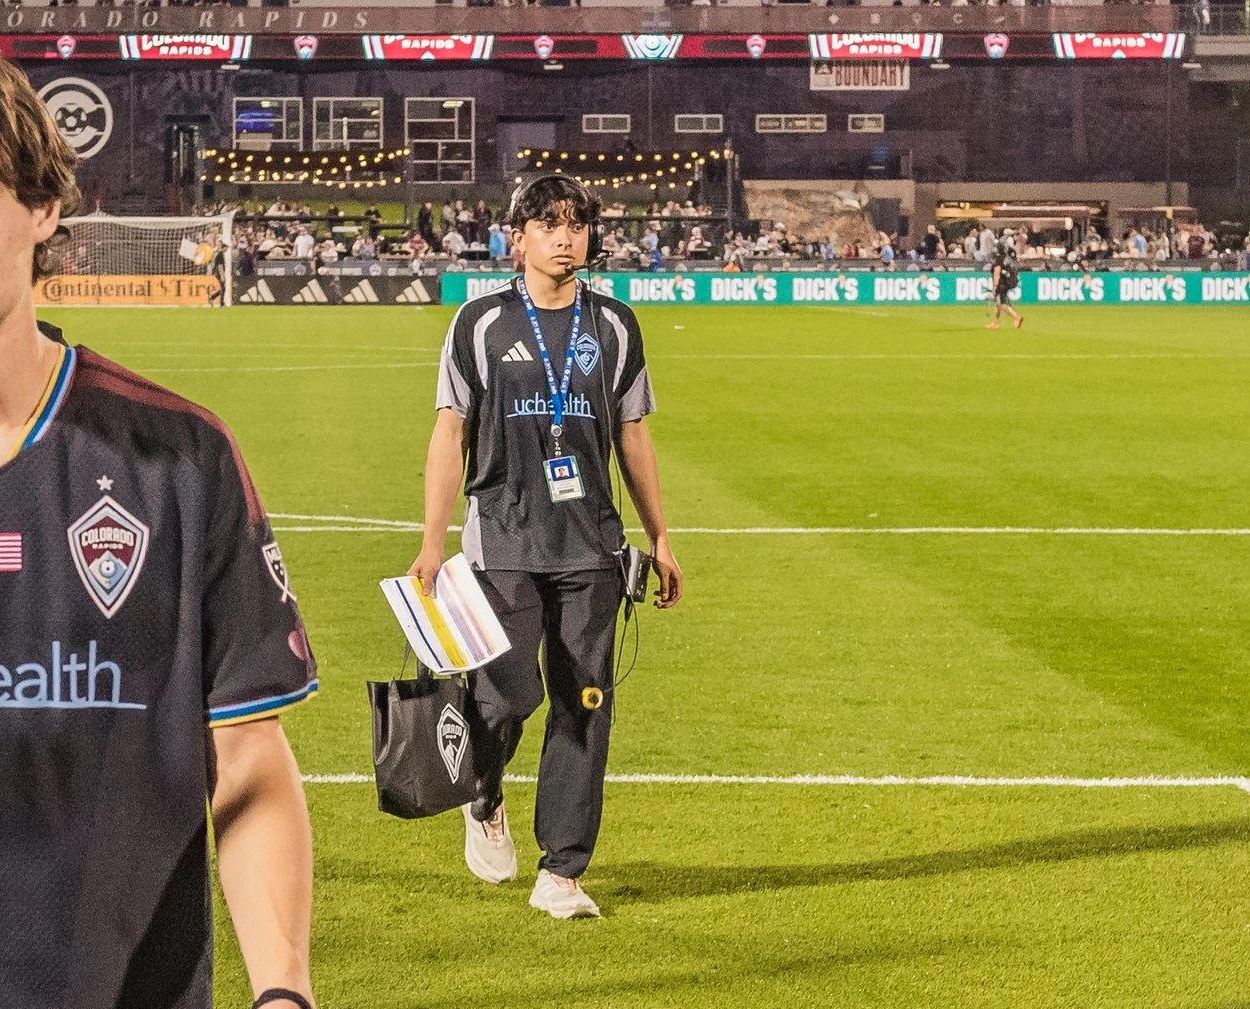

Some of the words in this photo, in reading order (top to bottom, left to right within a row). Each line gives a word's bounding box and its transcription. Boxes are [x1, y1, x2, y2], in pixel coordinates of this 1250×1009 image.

[199, 11, 369, 28] RAPIDS
[158, 45, 213, 55] RAPIDS
[401, 39, 455, 49] RAPIDS
[848, 44, 903, 54] RAPIDS
[1092, 37, 1146, 48] RAPIDS
[42, 278, 152, 301] Continental
[169, 278, 217, 297] Tire
[629, 275, 695, 301] DICK'S
[710, 275, 777, 301] DICK'S
[792, 275, 859, 301] DICK'S
[873, 275, 940, 301] DICK'S
[1037, 274, 1104, 301] DICK'S
[1119, 274, 1186, 301] DICK'S
[81, 526, 135, 547] COLORADO
